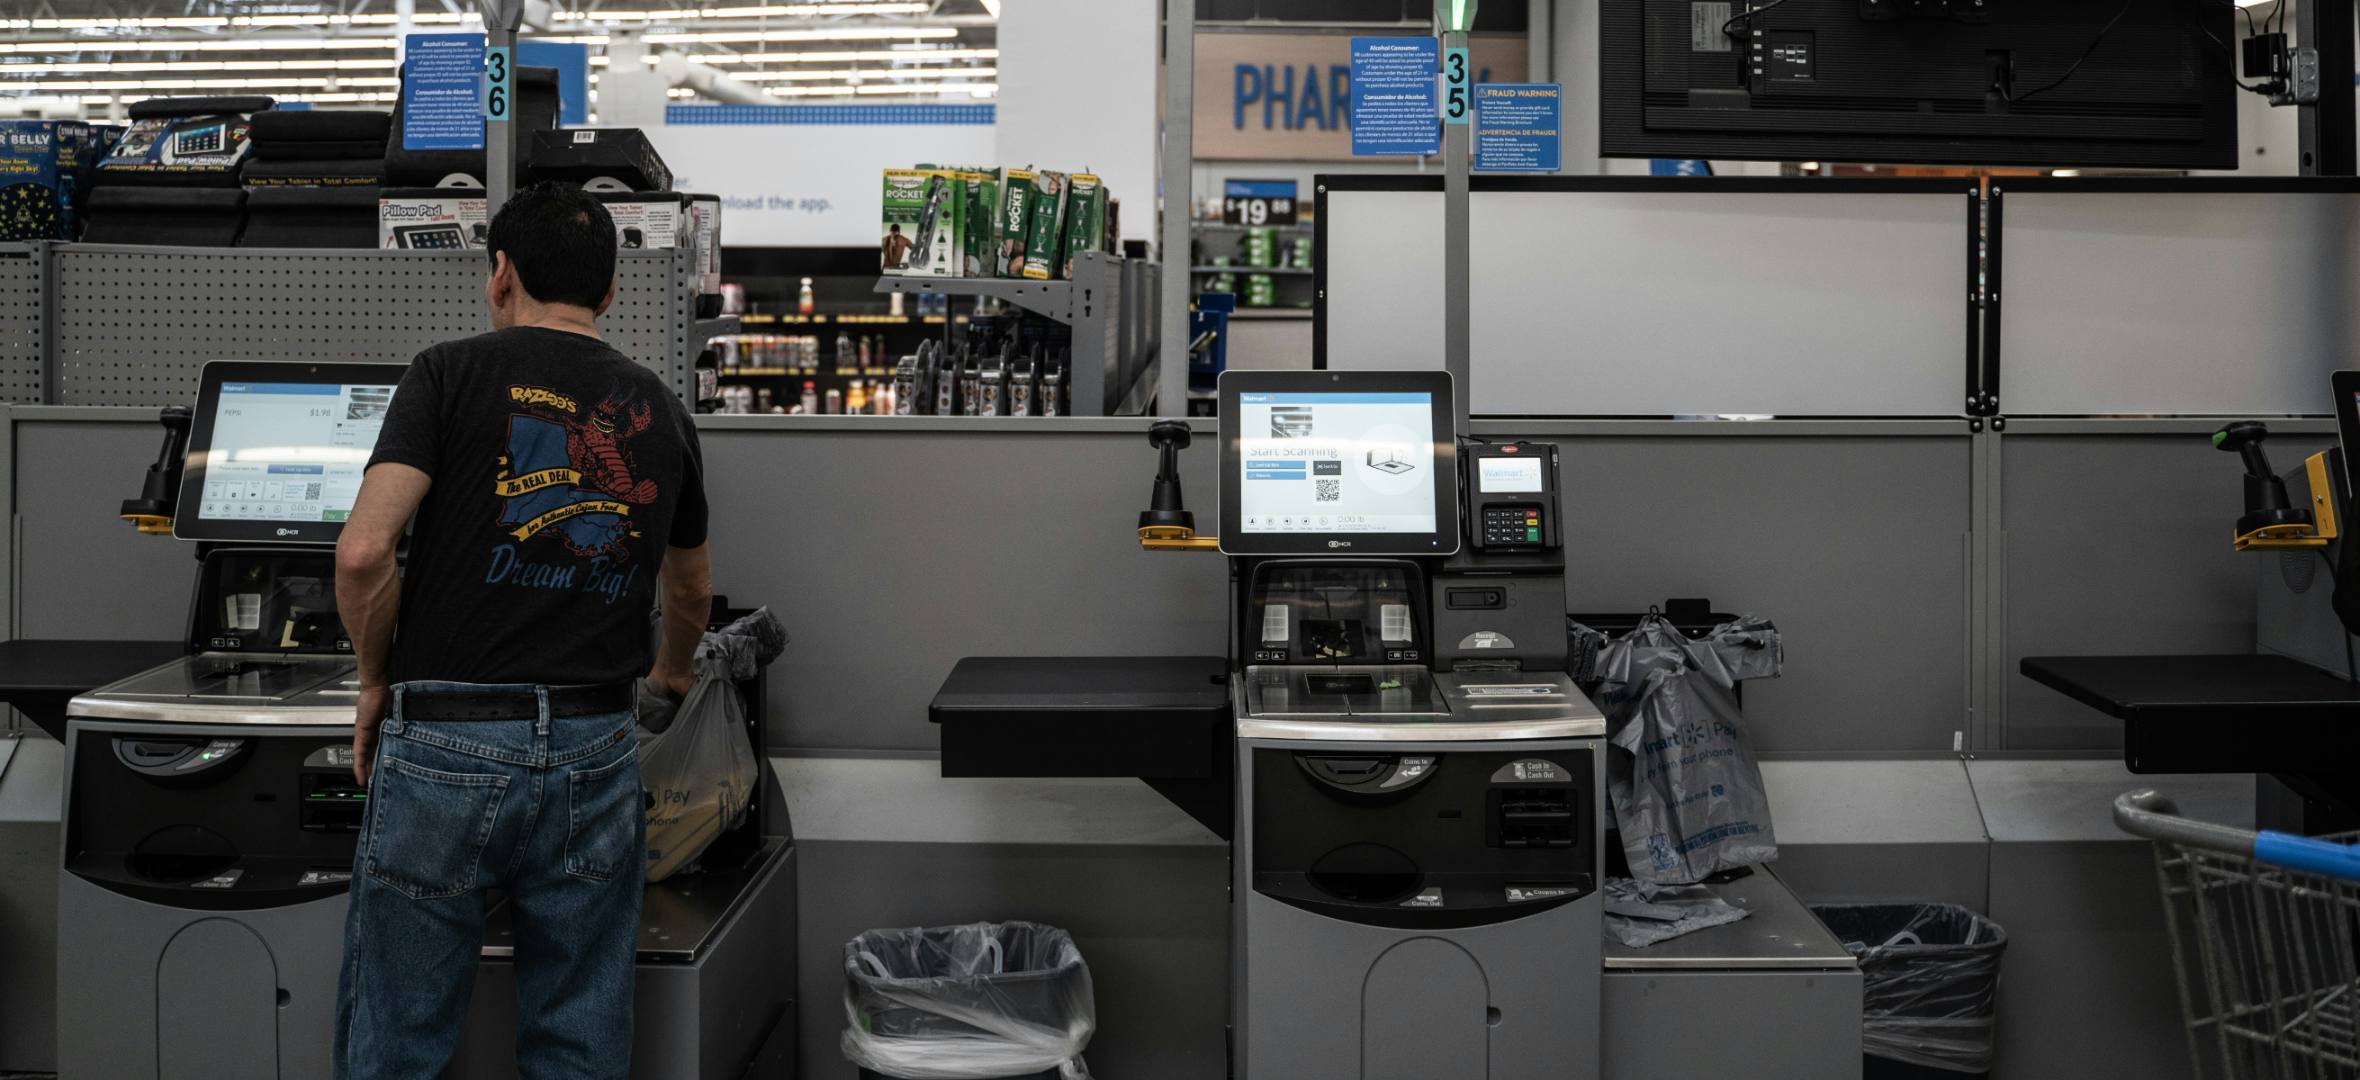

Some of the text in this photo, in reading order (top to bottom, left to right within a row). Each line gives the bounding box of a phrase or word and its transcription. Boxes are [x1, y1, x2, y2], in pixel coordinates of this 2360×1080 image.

[1487, 89, 1558, 97] FRAUD WARNING
[11, 134, 50, 145] BELLY
[288, 177, 313, 185] Tablet
[886, 188, 924, 200] ROCKET
[382, 204, 442, 217] Pillow Pad
[769, 195, 795, 210] the
[799, 198, 833, 214] app.
[1009, 187, 1024, 233] ROCKET
[507, 471, 571, 494] The REAL DEAL
[540, 508, 575, 526] Authentic
[485, 543, 577, 589] Dream
[1698, 747, 1734, 762] phone
[664, 788, 691, 806] Pay
